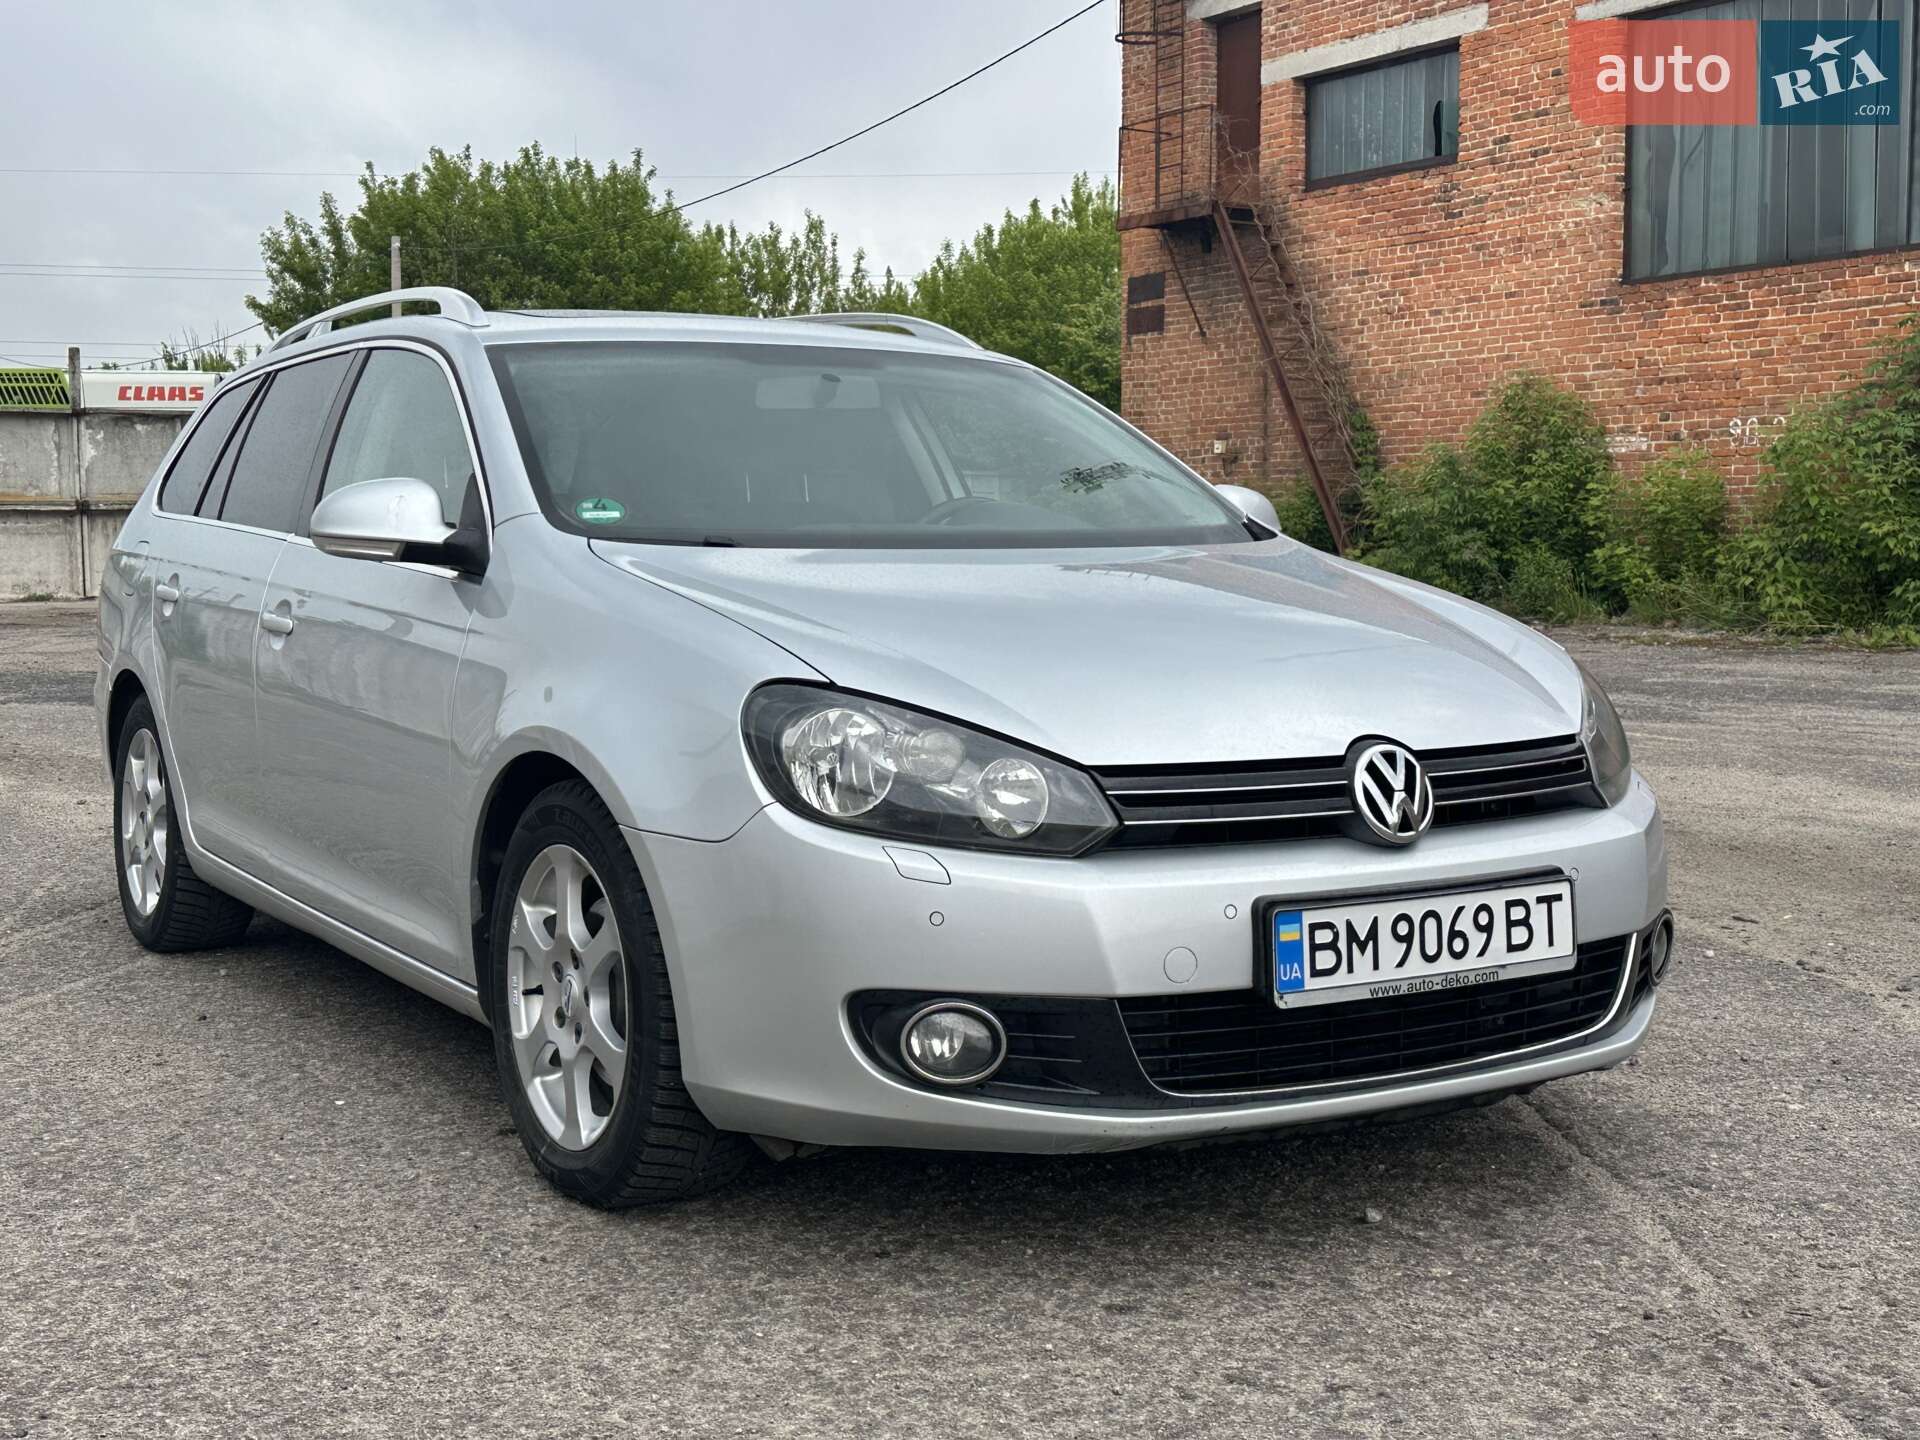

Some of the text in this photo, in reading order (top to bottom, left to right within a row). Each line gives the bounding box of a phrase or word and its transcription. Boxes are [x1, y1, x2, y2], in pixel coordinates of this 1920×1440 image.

[117, 385, 204, 401] CLAAS
[1308, 893, 1563, 978] BM 9069 BT
[1280, 962, 1302, 981] UA
[1369, 968, 1499, 998] www.auto-deko.com
